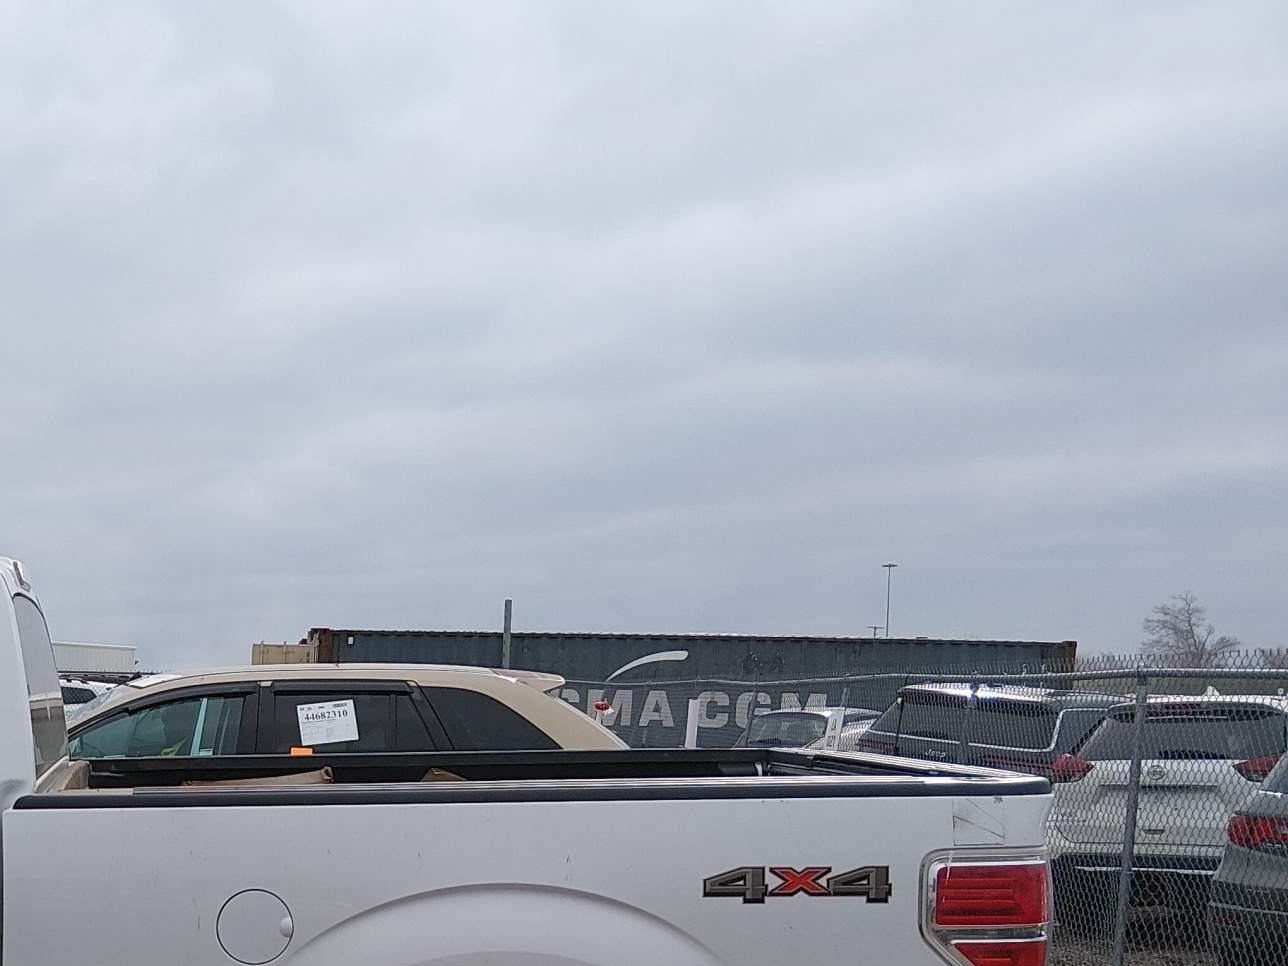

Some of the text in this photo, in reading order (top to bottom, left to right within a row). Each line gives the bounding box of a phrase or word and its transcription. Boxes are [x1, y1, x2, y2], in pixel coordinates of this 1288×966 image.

[550, 688, 675, 727] MA
[304, 709, 349, 721] 44682310
[925, 748, 946, 758] Jeep
